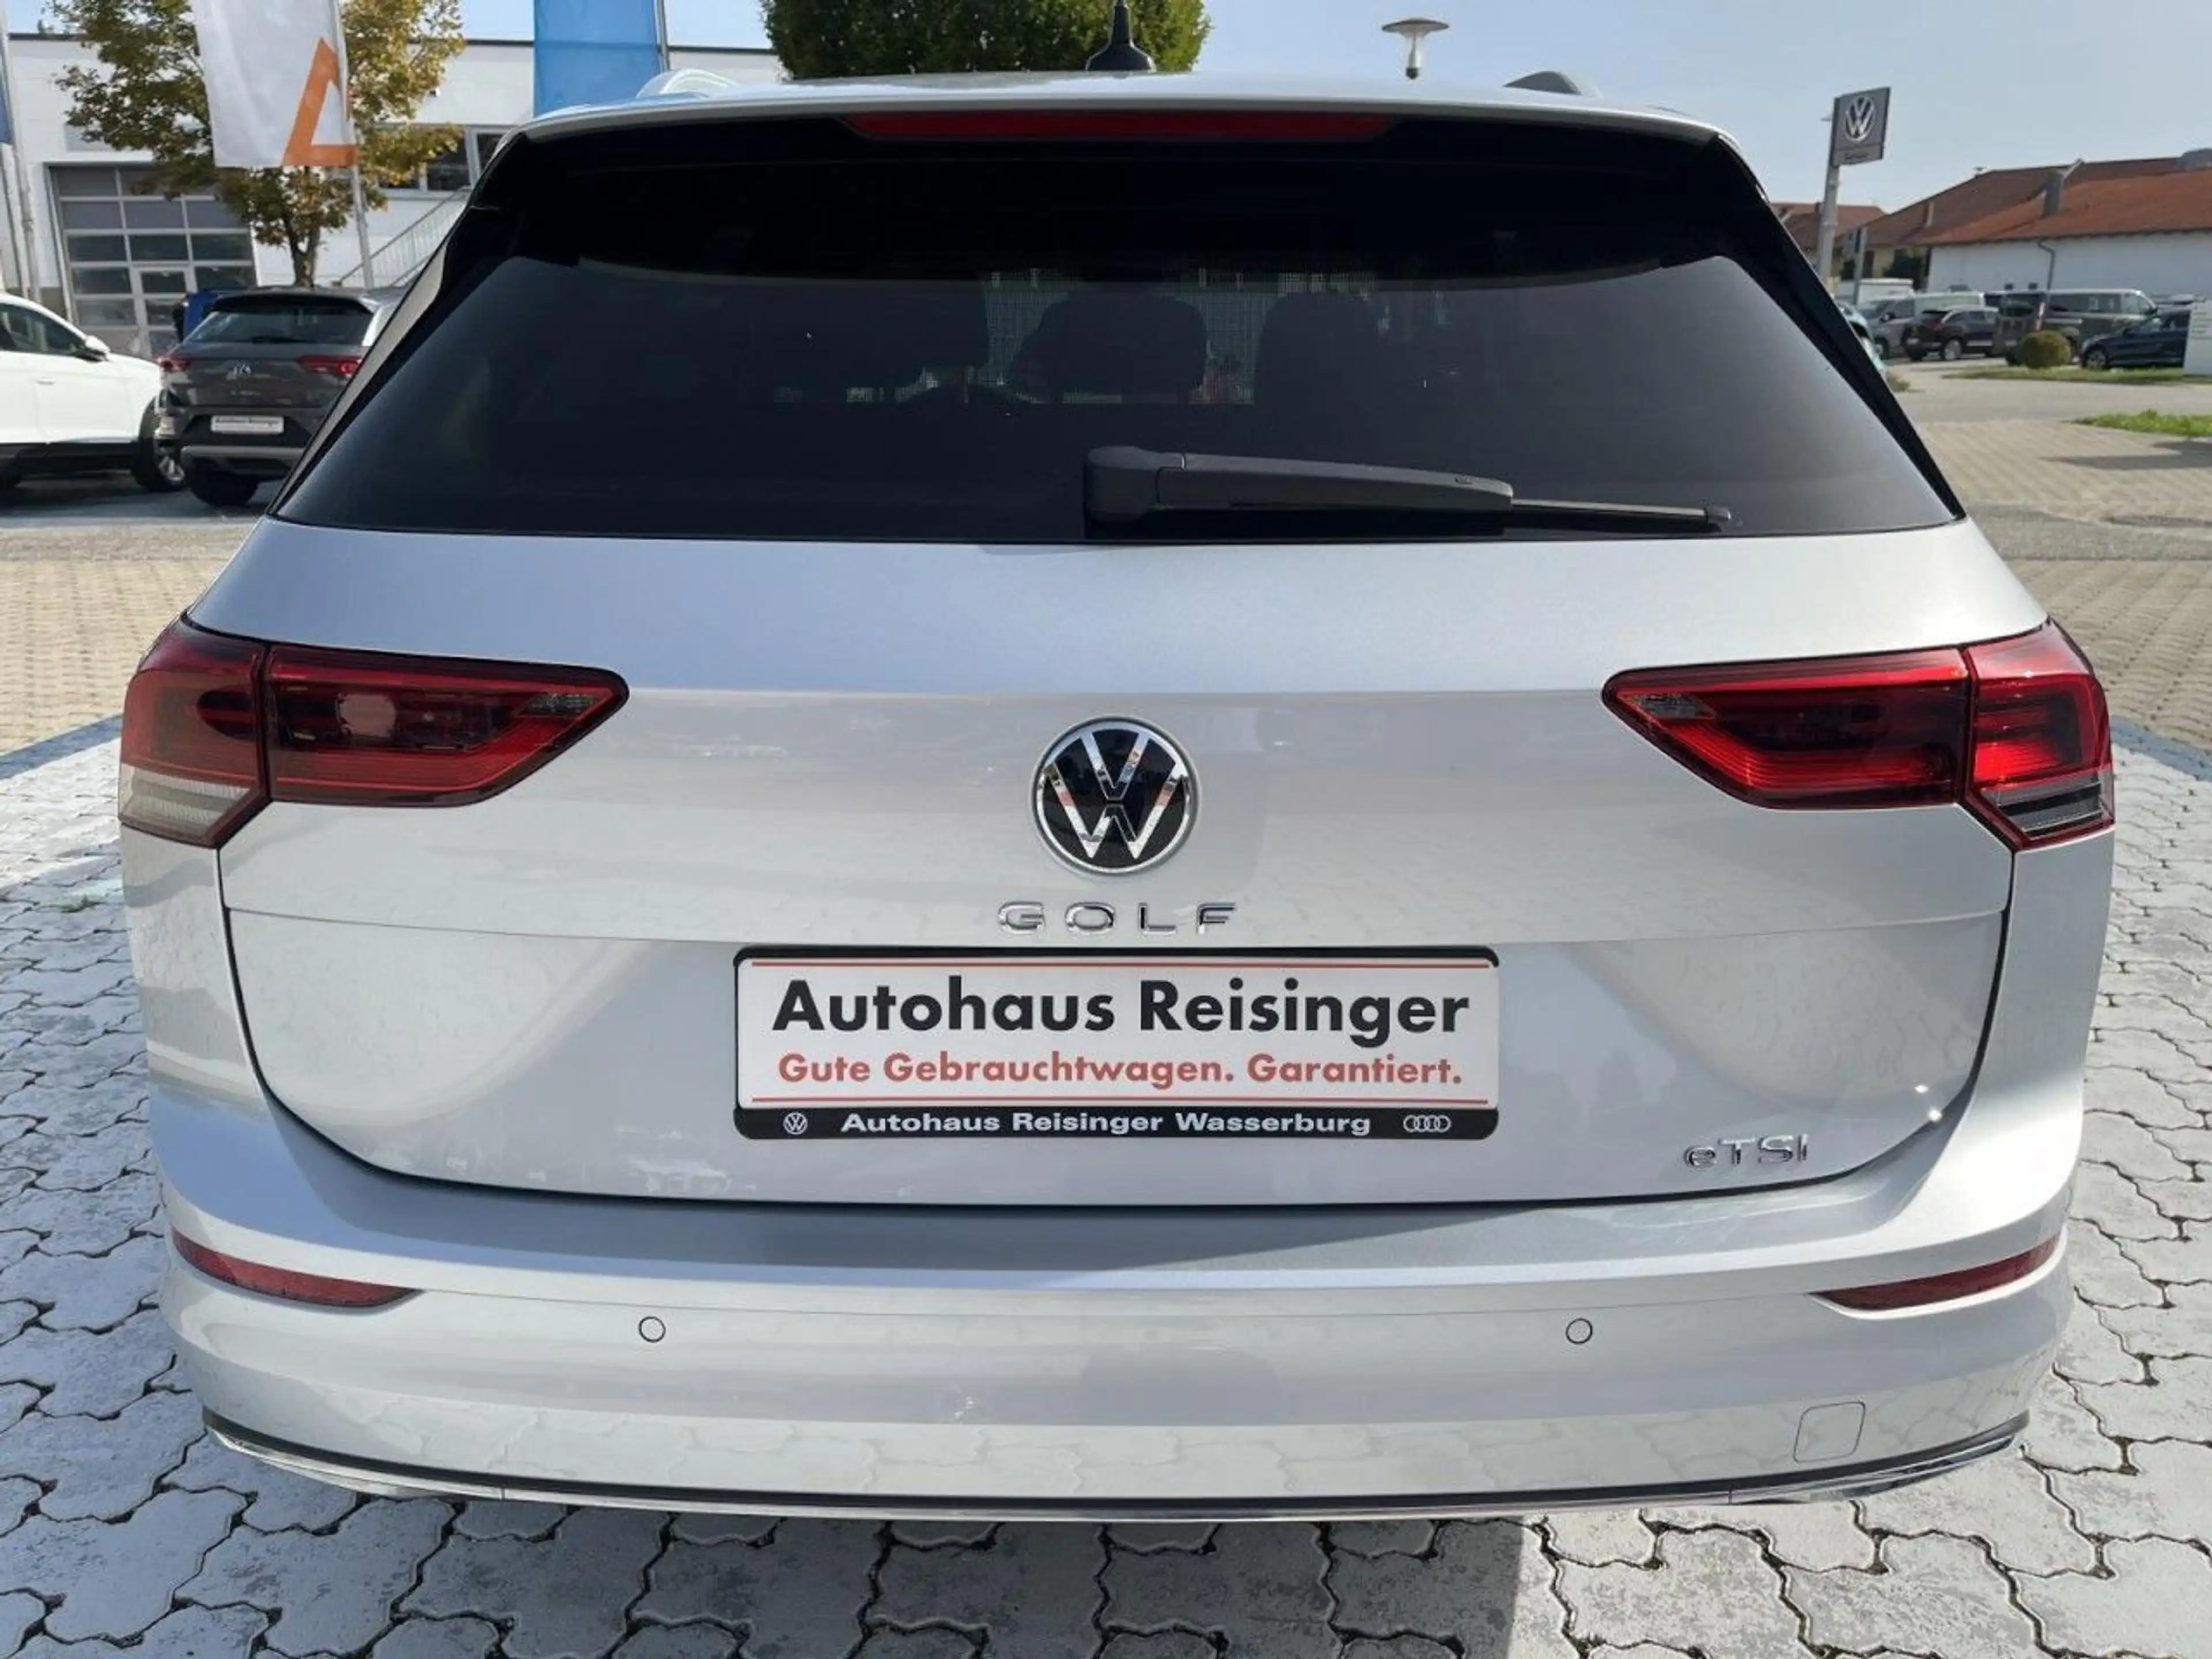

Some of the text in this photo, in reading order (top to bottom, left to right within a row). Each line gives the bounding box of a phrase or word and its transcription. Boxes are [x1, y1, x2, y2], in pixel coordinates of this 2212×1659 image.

[998, 901, 1236, 934] GOLF
[772, 975, 1469, 1048] Autohaus Reisinger
[778, 1051, 1463, 1089] Gute Gebrauchtwagen. Garantiert.
[841, 1113, 1000, 1132] Autohaus
[1013, 1112, 1163, 1135] Reisinger
[1175, 1112, 1370, 1136] Wasserburg
[1684, 1132, 1809, 1168] eTSI
